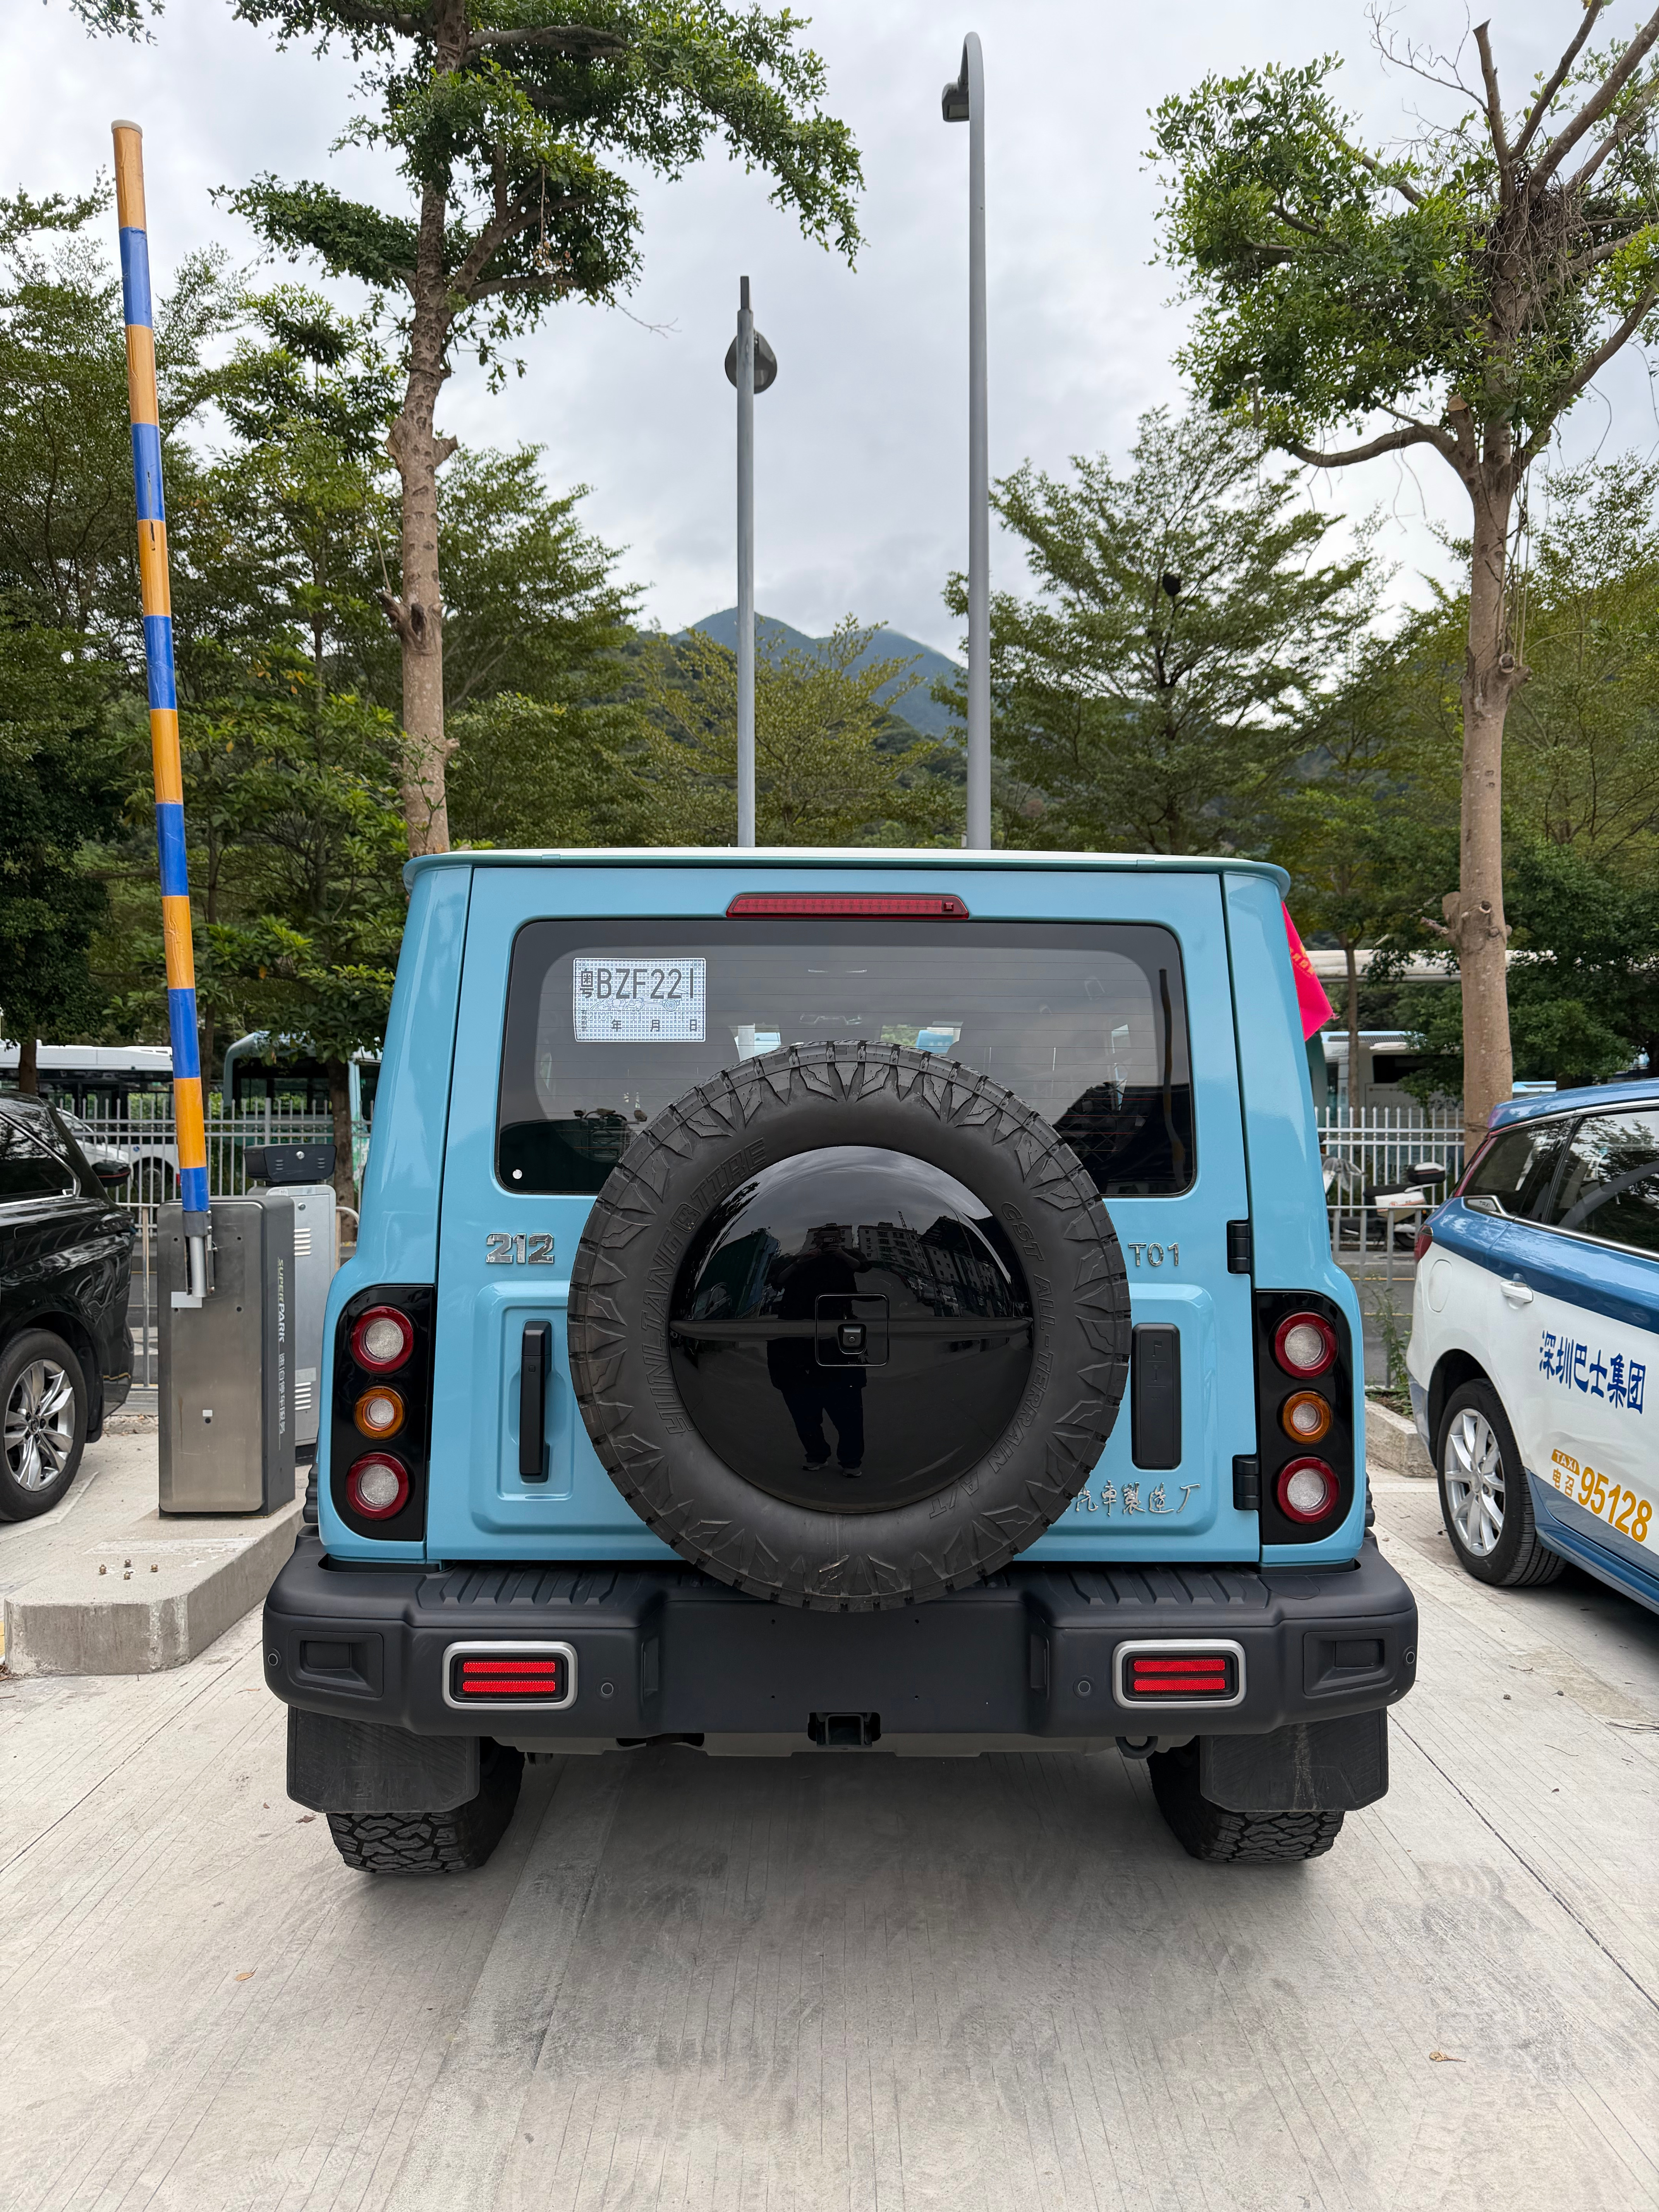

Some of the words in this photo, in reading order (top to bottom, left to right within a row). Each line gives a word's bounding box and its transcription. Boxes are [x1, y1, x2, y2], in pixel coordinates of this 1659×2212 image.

[579, 968, 694, 999] 粤BZF221
[611, 1019, 622, 1032] 年
[650, 1019, 660, 1032] 月
[690, 1137, 767, 1213] TIRE
[486, 1232, 555, 1264] 212
[988, 1273, 1055, 1474] ALL-TERRAIN
[1539, 1330, 1646, 1414] 深圳巴士集团
[1554, 1450, 1578, 1472] TAXI
[1552, 1468, 1575, 1498] 电召
[1578, 1467, 1652, 1542] 95128
